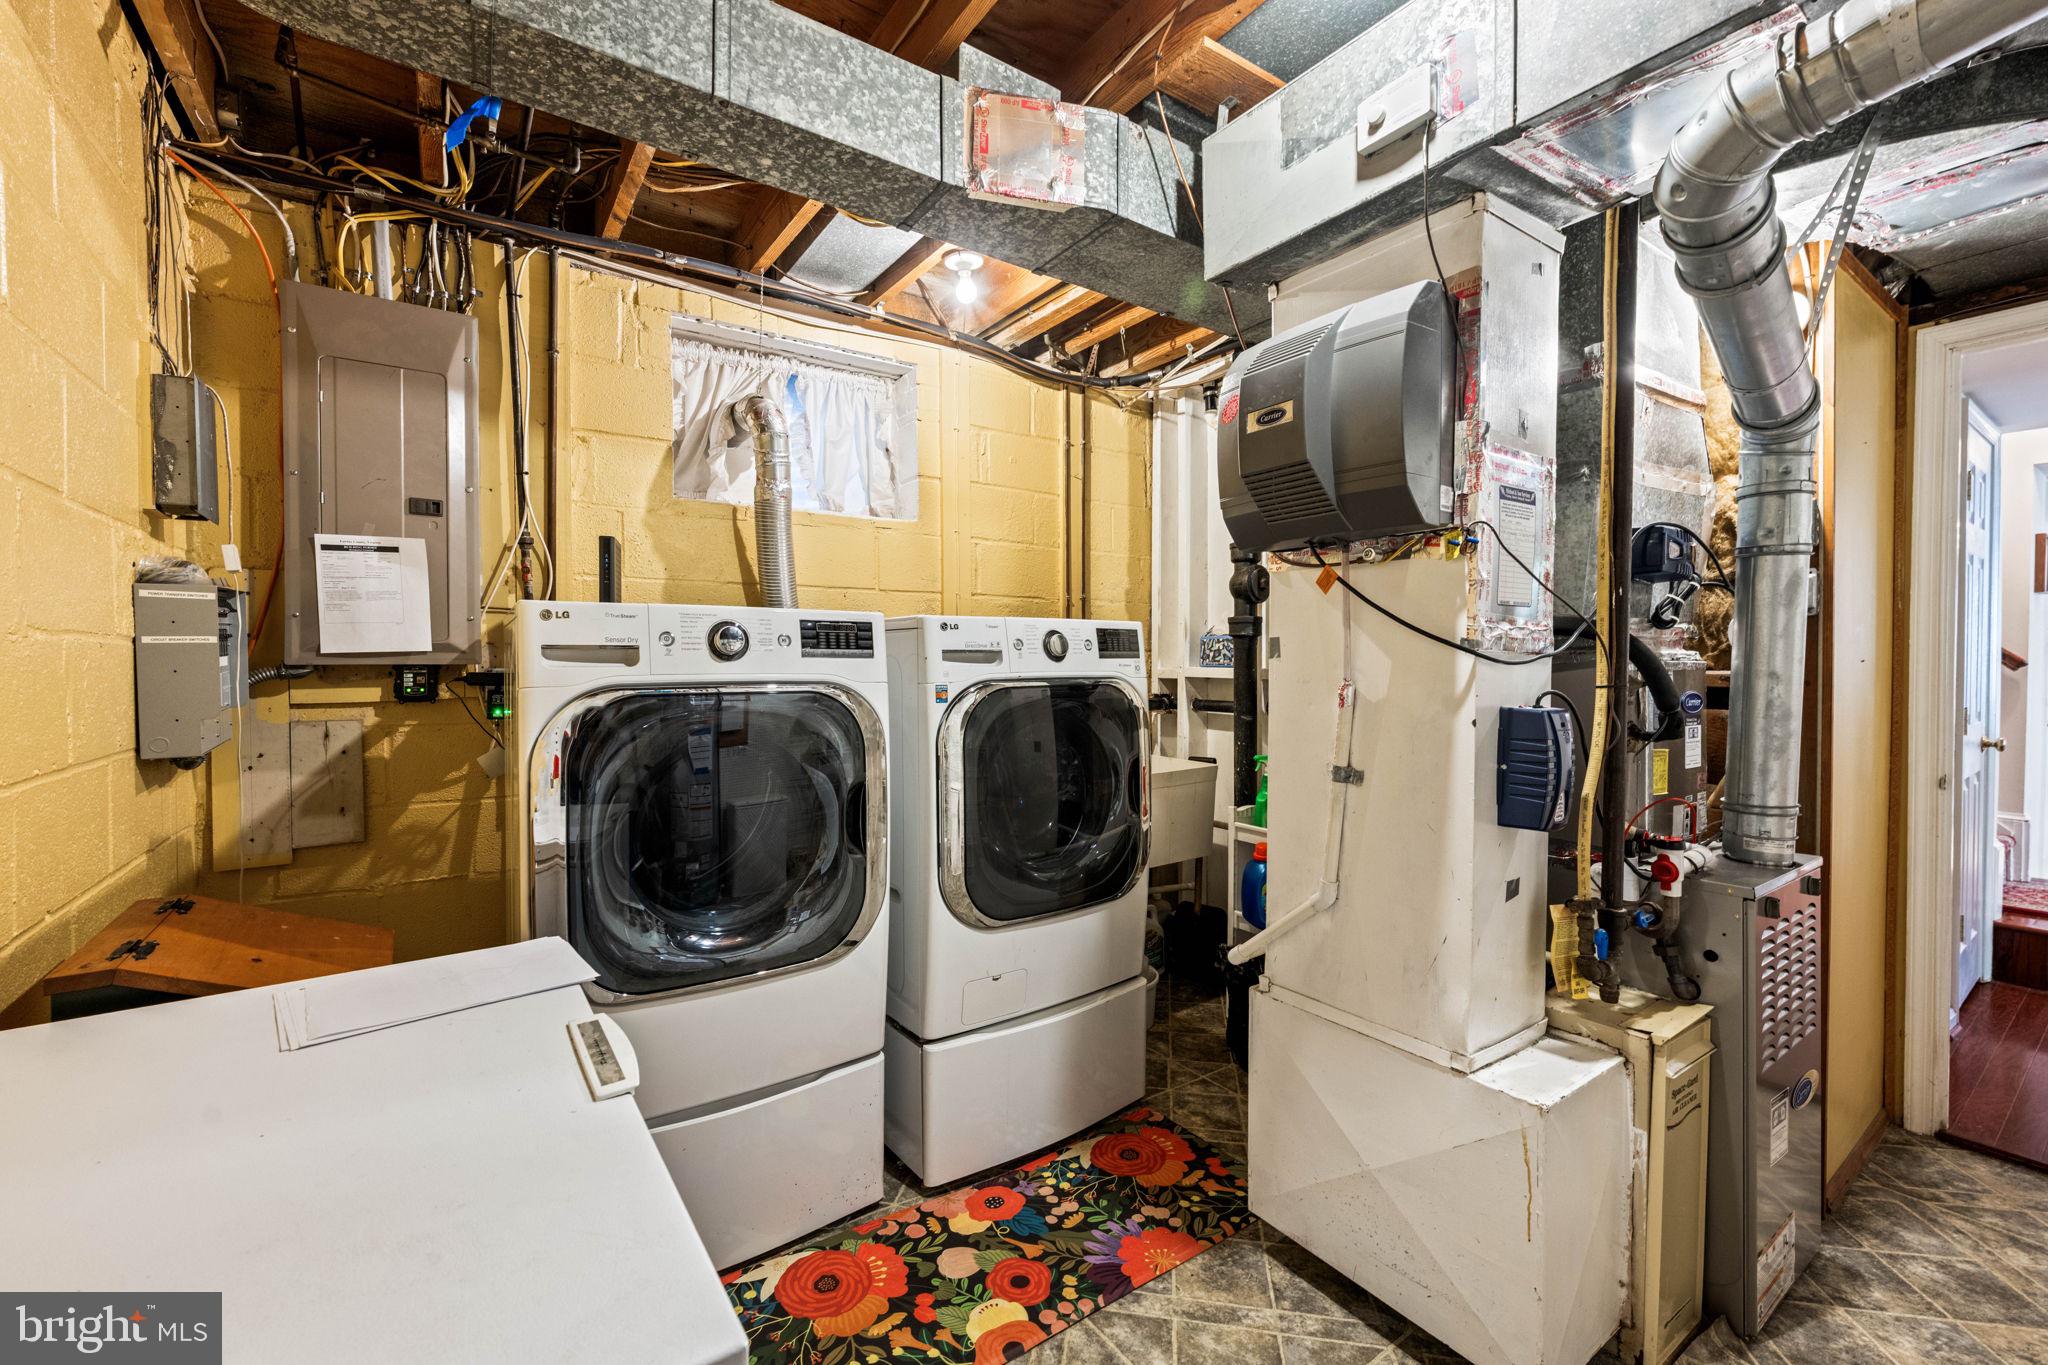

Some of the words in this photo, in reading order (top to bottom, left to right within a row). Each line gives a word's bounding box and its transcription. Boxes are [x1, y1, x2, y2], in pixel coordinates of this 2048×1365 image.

[1260, 411, 1283, 423] Carrier
[555, 611, 570, 619] LG
[627, 636, 639, 644] Dry
